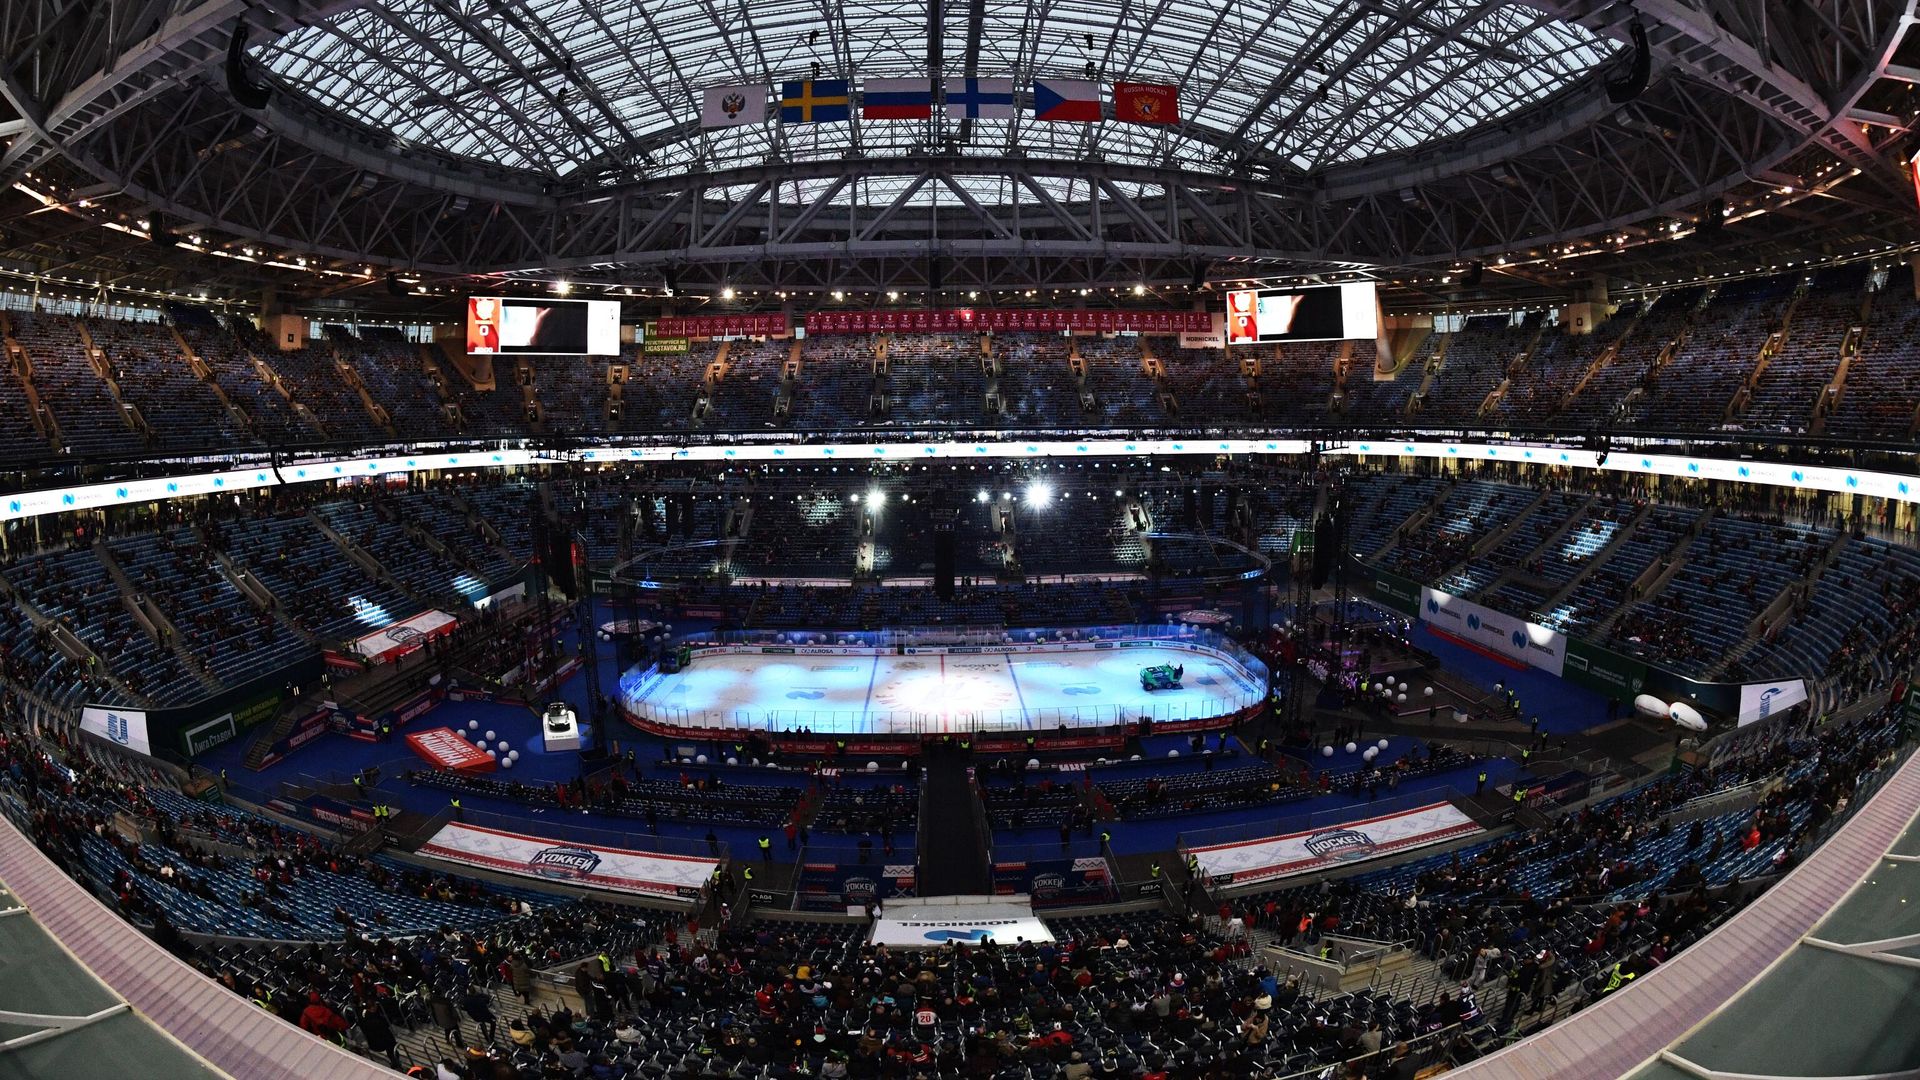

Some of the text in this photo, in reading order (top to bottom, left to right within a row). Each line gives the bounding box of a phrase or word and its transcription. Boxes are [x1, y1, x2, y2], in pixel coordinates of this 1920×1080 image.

[1124, 86, 1168, 96] RUSSIA HOCKEY
[413, 733, 468, 766] МАШИНА
[1311, 835, 1366, 853] HOCKEY
[897, 919, 1018, 927] NORNICKEL
[920, 1015, 931, 1023] 20
